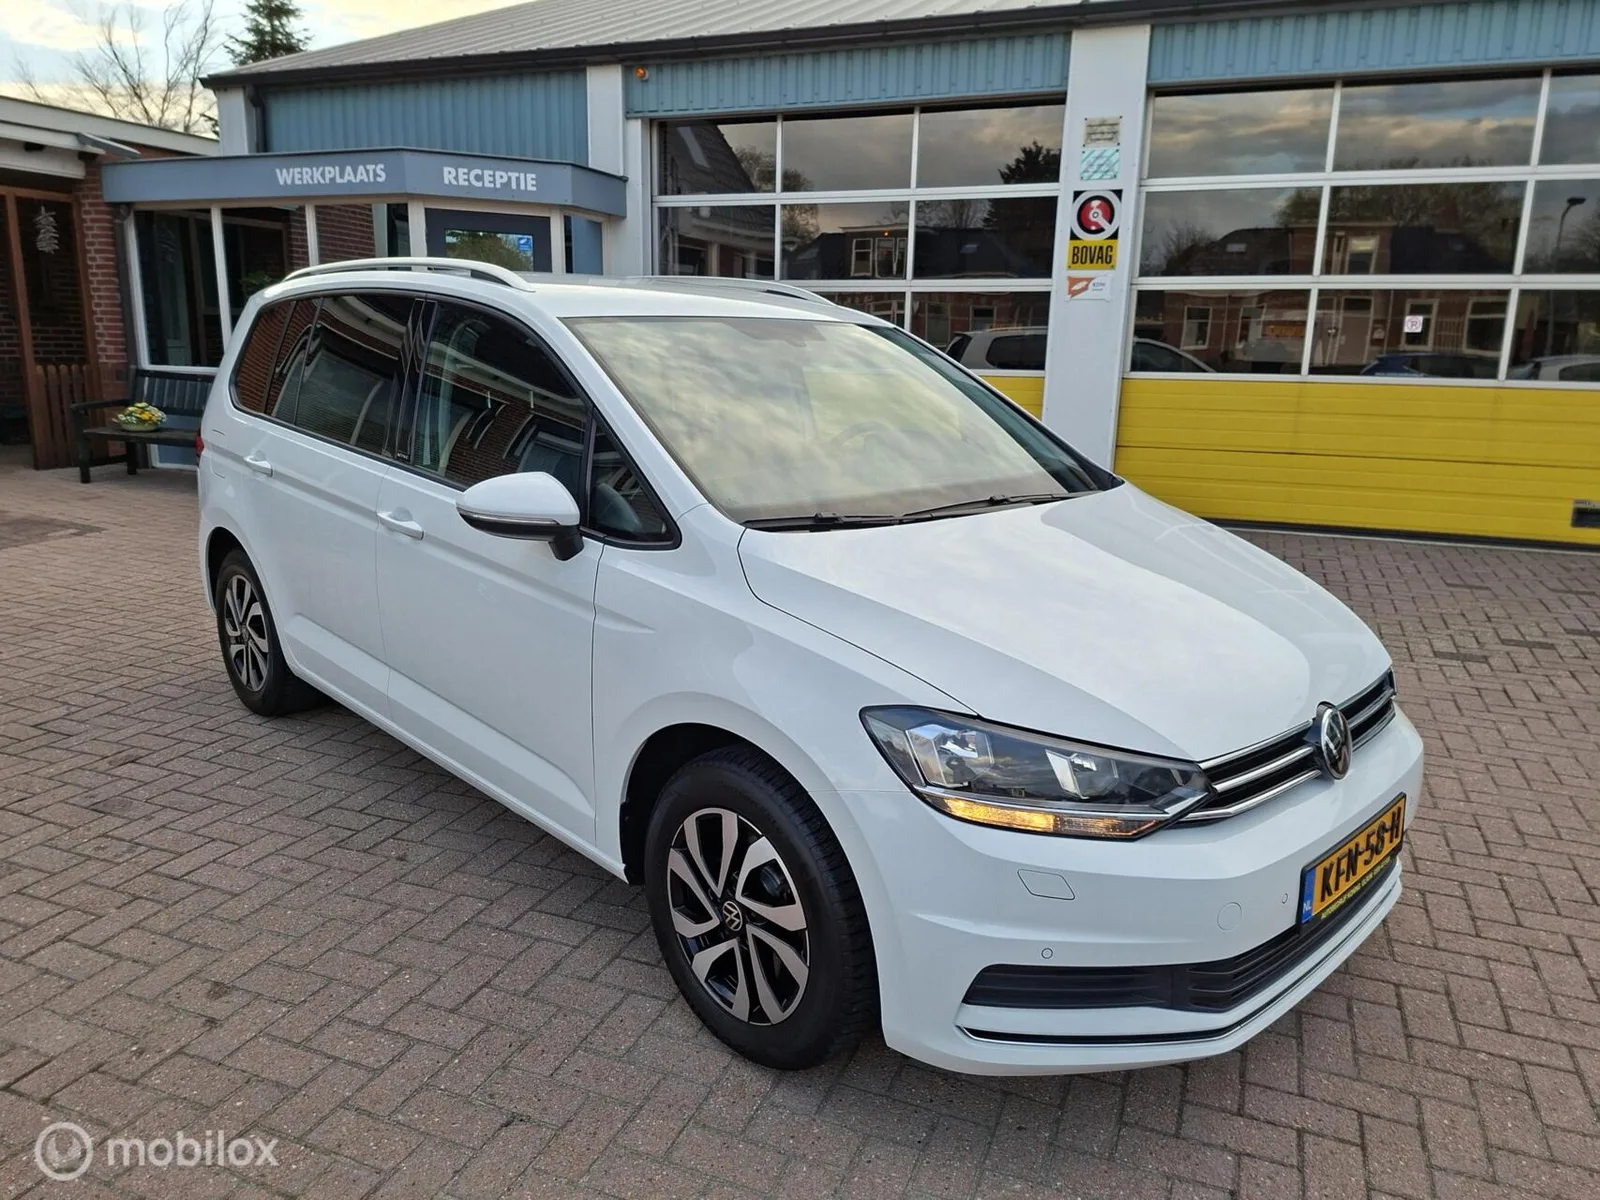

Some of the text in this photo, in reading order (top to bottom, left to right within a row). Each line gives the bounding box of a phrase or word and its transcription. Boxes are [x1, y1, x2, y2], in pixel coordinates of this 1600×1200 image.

[275, 163, 387, 186] WERKPLAATS
[442, 166, 537, 191] RECEPTIE
[1071, 244, 1114, 265] BOVAG
[1320, 805, 1402, 903] KFN-58-H
[1302, 900, 1313, 915] NL
